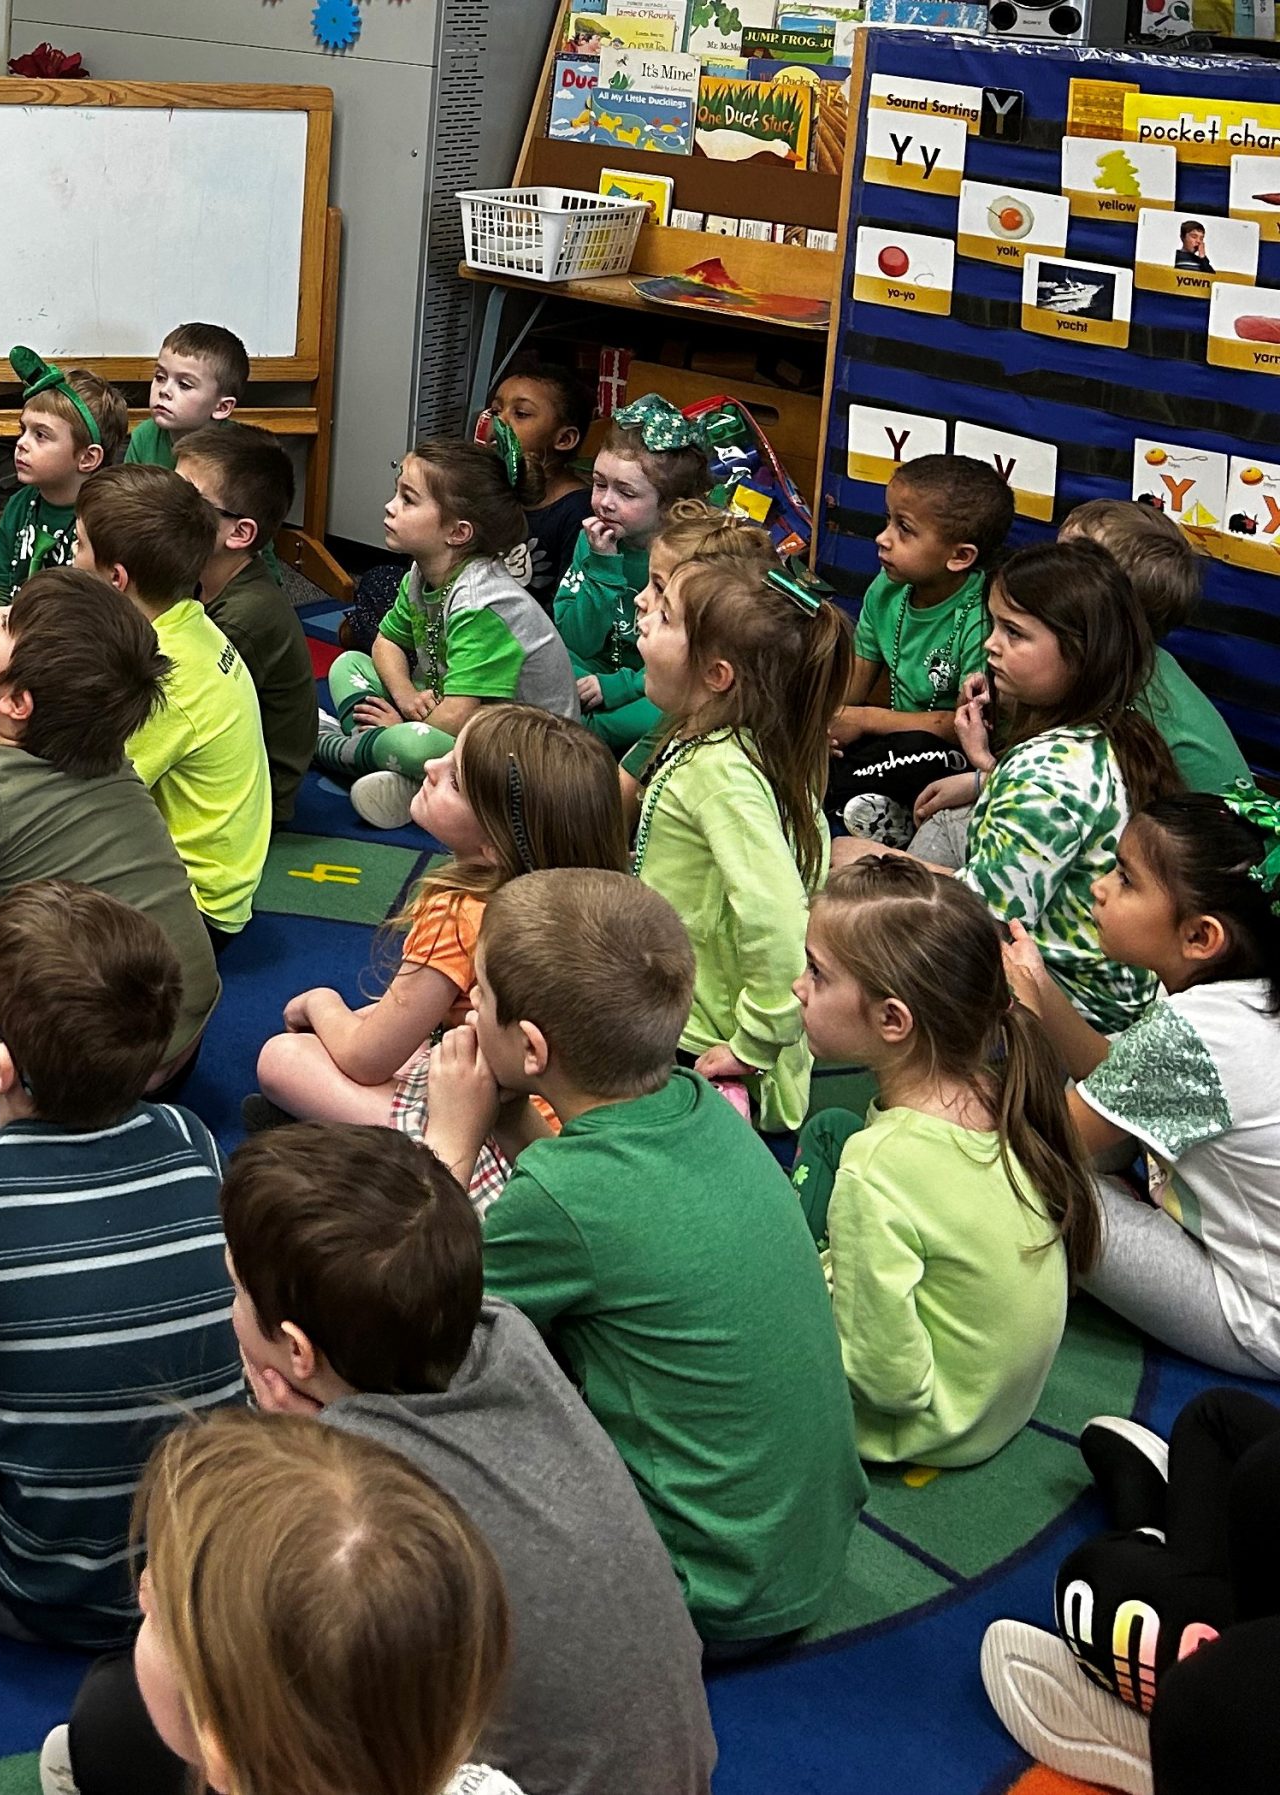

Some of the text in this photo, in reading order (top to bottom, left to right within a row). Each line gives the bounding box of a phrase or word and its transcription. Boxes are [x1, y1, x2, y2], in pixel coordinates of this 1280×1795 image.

[641, 62, 696, 82] It's Mine!
[598, 92, 687, 109] All My Little Ducklings
[886, 94, 980, 121] Sound Sorting
[986, 92, 1018, 134] Y
[698, 105, 796, 136] One Duck Stuck
[1140, 118, 1219, 143] pocket
[889, 133, 941, 180] Y y
[1097, 199, 1136, 212] yellow
[996, 245, 1020, 257] yolk
[887, 288, 915, 301] yo-yo
[1176, 276, 1210, 289] yawn
[1056, 319, 1088, 333] yacht
[884, 426, 910, 462] Y
[1160, 473, 1196, 513] Y
[853, 750, 967, 778] Champion
